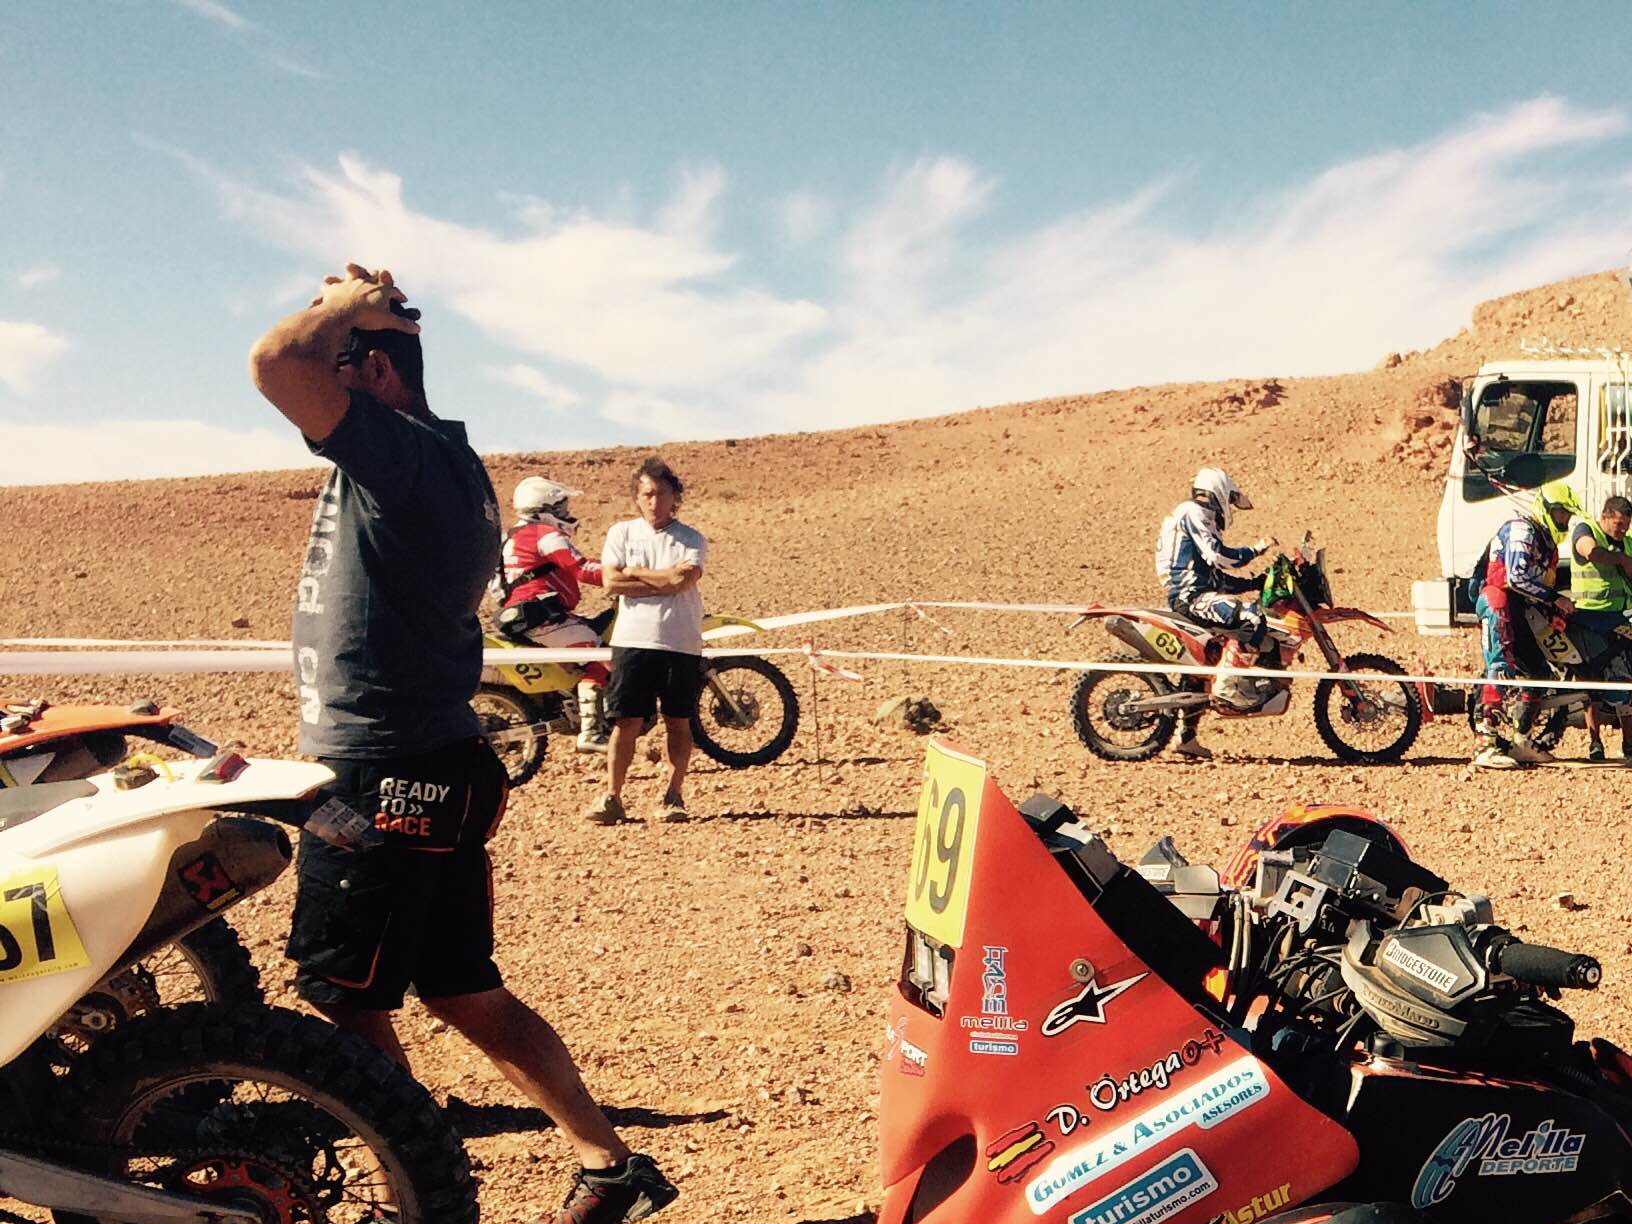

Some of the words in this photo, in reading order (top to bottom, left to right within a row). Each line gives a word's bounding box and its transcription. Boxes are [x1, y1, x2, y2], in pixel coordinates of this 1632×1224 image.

[378, 795, 406, 815] TO
[379, 777, 450, 803] READY
[374, 811, 431, 836] RACE
[1386, 941, 1454, 990] BRIDGESTONE
[973, 1042, 1016, 1053] turismo
[1089, 1053, 1182, 1111] Ortega
[1200, 1081, 1263, 1124] ASESORES
[1033, 1150, 1110, 1204] GOMEZ
[1111, 1140, 1129, 1157] &
[1132, 1066, 1256, 1145] ASOCIADOS
[1462, 1113, 1586, 1165] Melilla
[1477, 1155, 1580, 1176] DEPORTE
